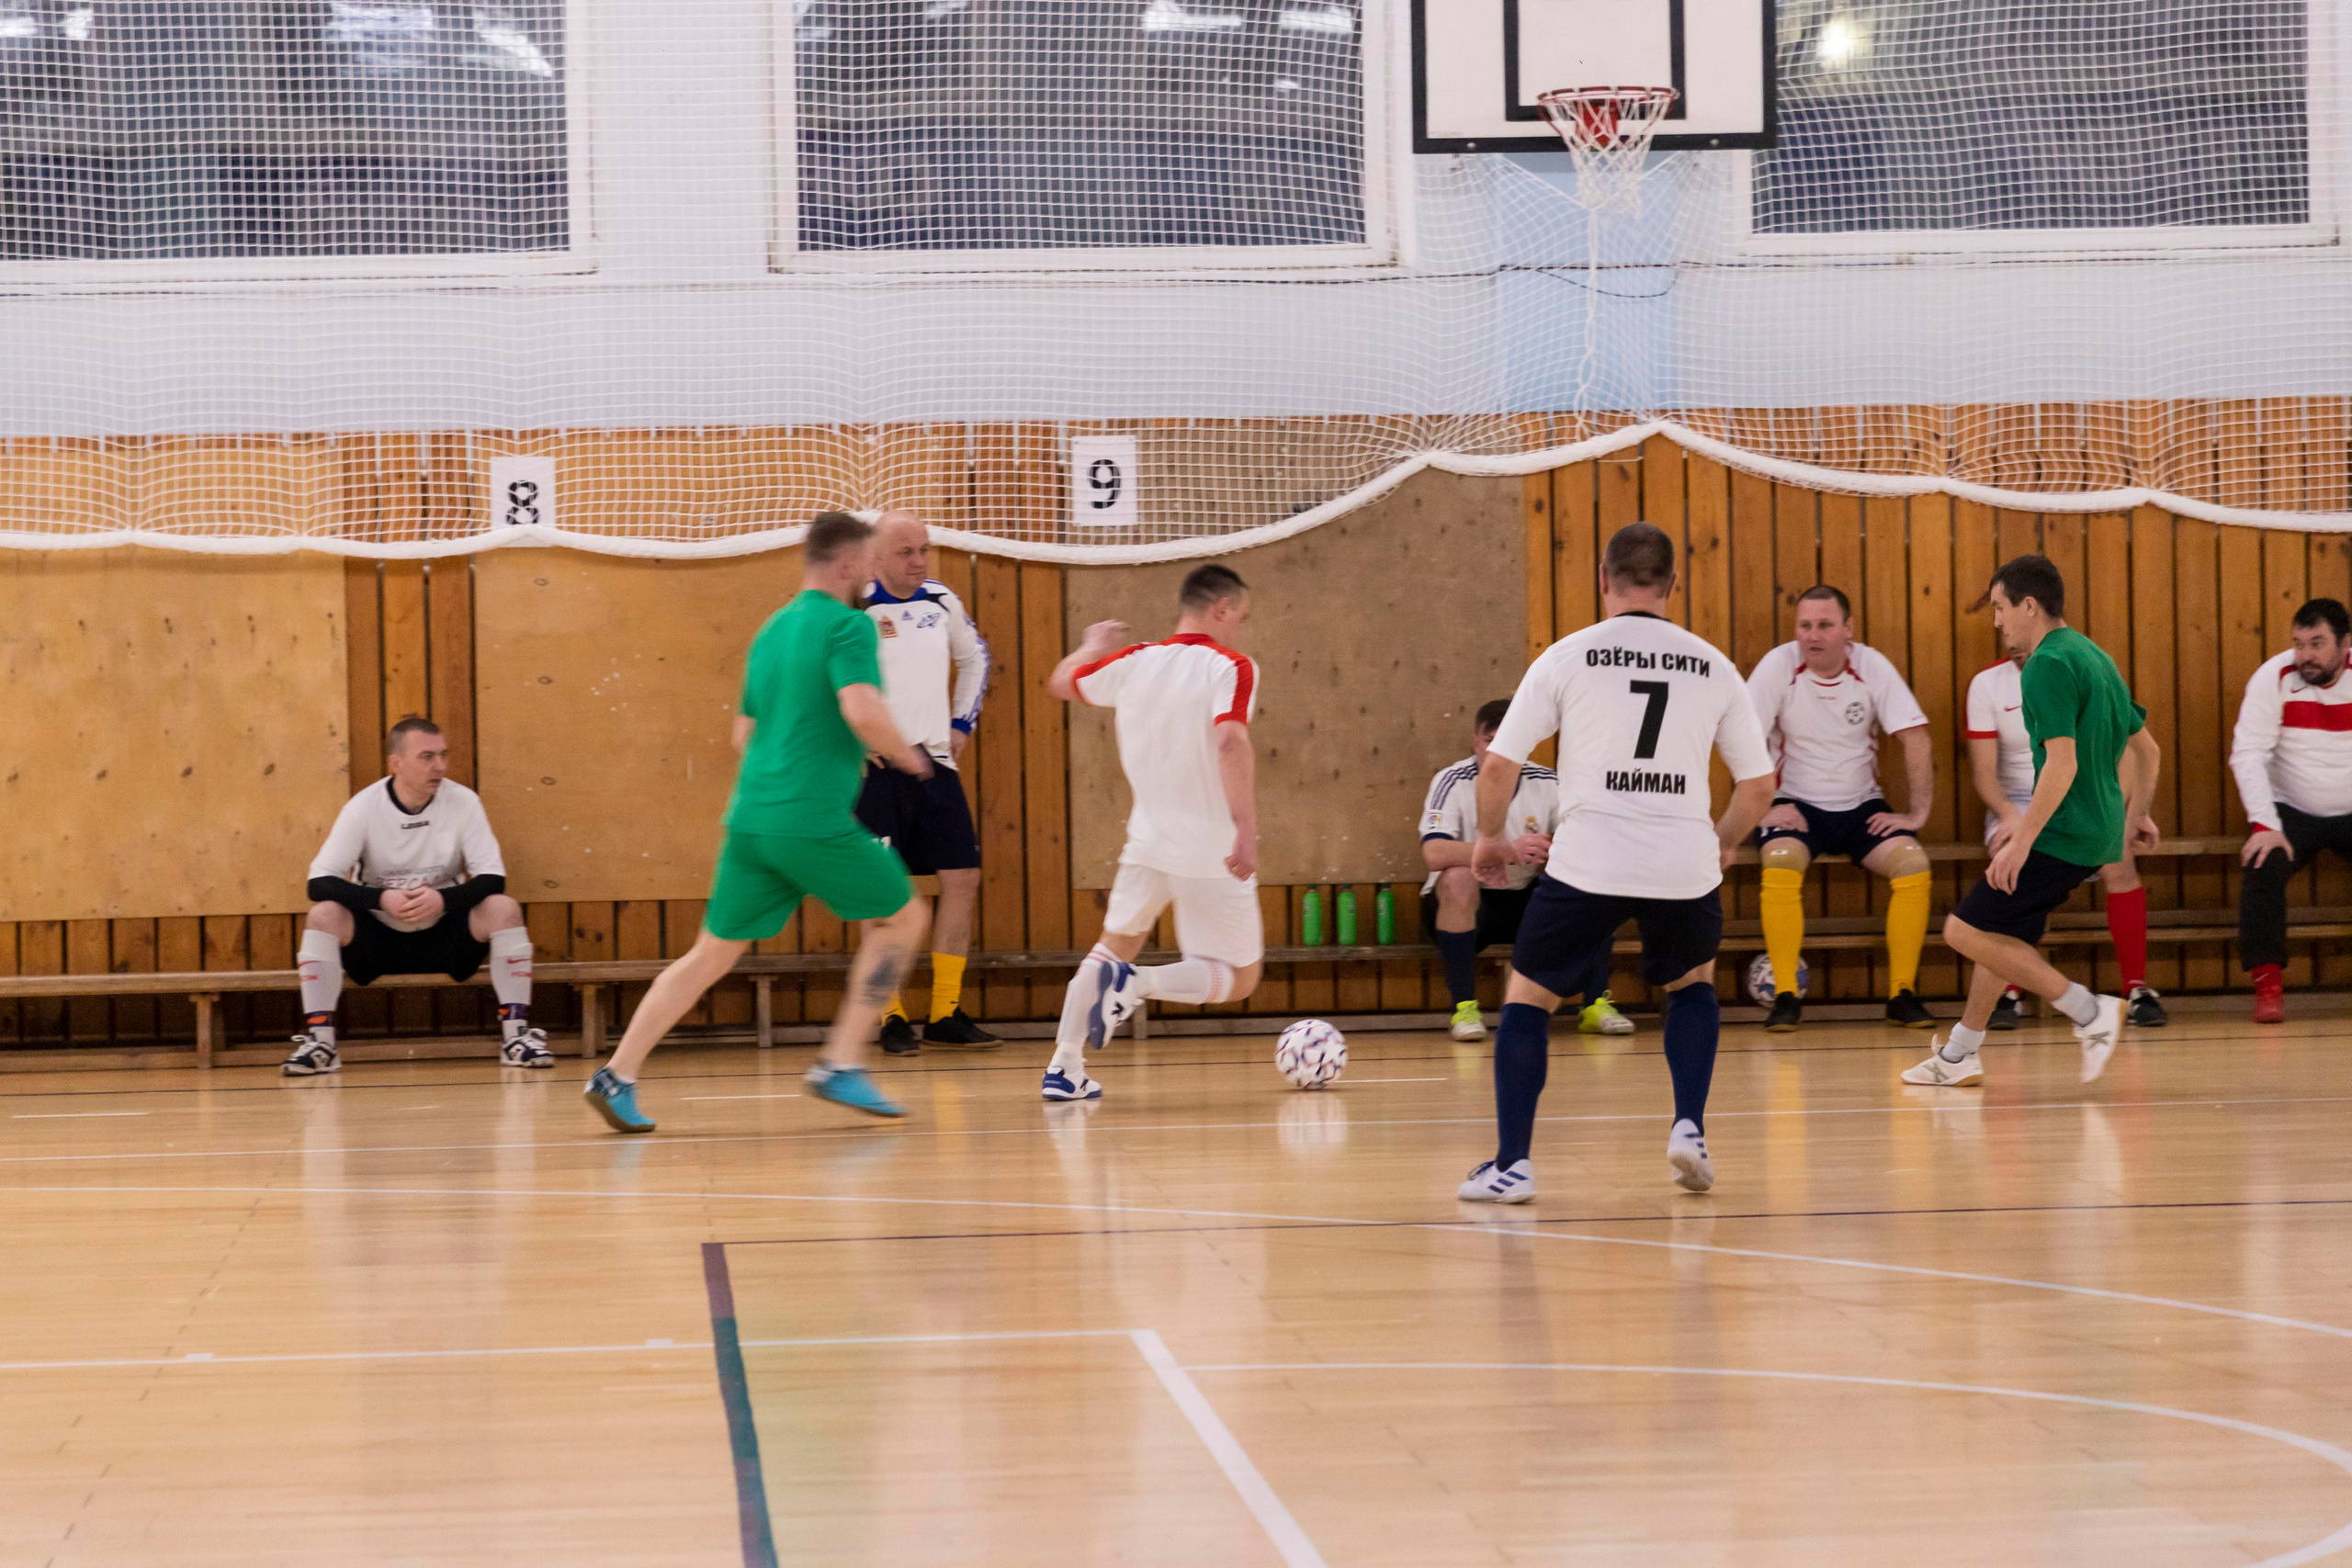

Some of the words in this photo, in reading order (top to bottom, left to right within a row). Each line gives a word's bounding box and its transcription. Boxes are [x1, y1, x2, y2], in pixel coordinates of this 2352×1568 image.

[506, 479, 539, 525] 8
[1088, 458, 1121, 509] 9
[1586, 646, 1656, 670] ОЗЁРЫ
[1661, 652, 1710, 678] СИТИ
[1629, 679, 1669, 760] 7
[1605, 767, 1686, 795] КАЙМАН
